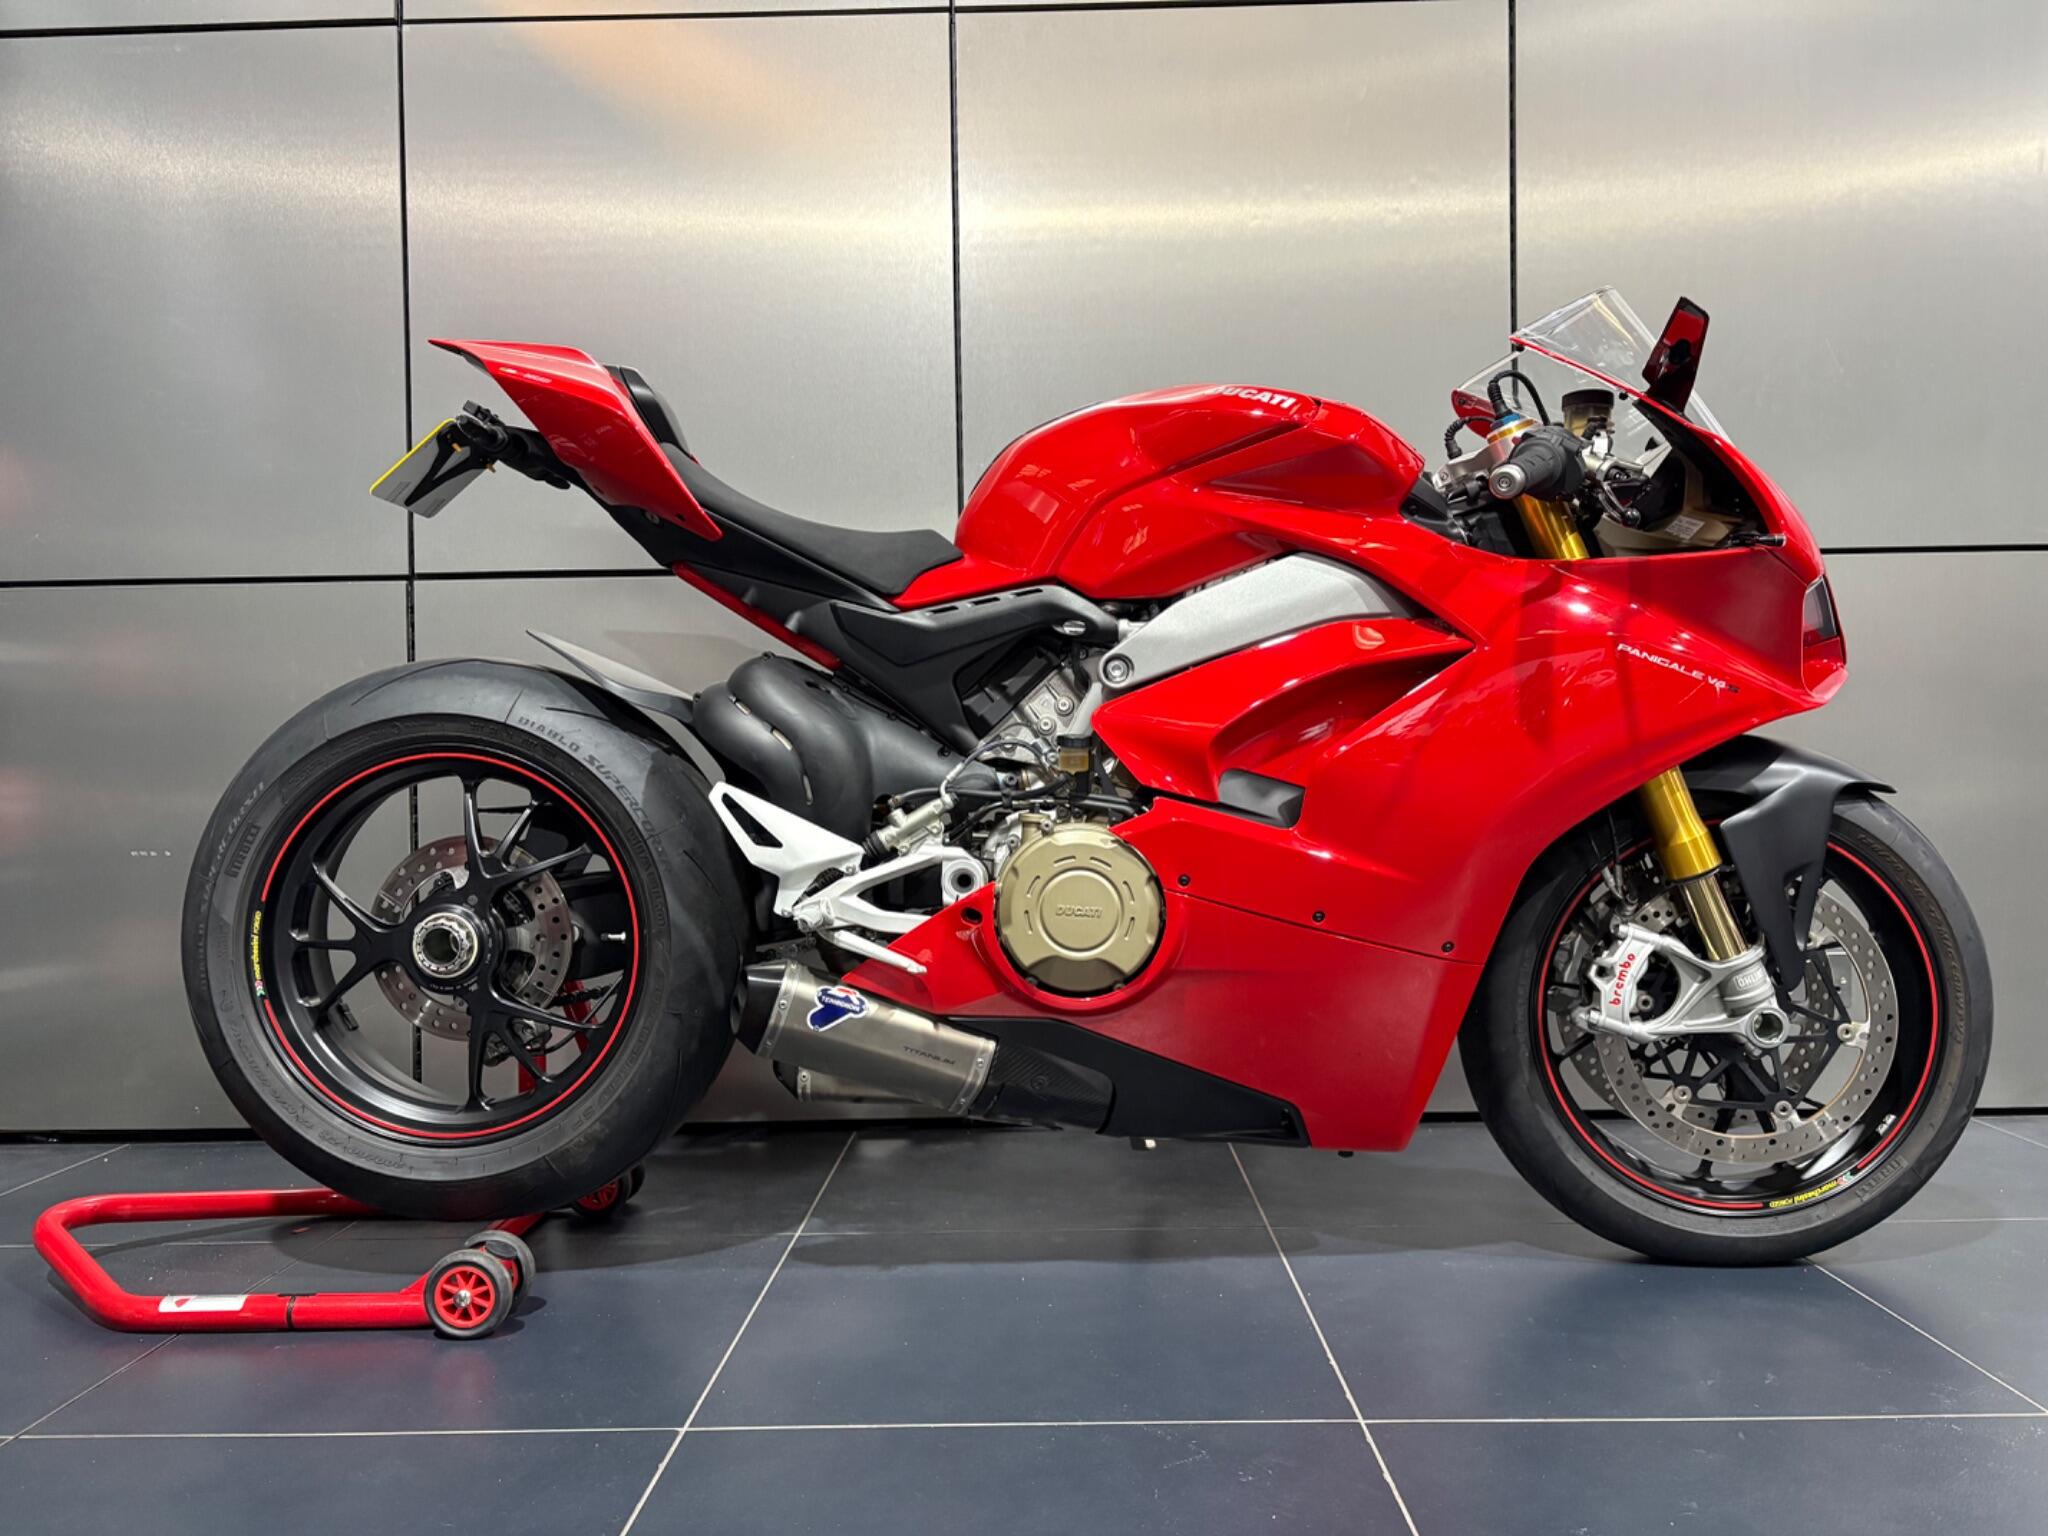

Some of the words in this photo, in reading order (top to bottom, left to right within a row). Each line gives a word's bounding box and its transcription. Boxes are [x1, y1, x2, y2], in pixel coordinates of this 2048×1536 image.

[517, 716, 582, 753] DIABLO
[1055, 904, 1103, 919] DUCATI
[1609, 953, 1637, 1007] brembo
